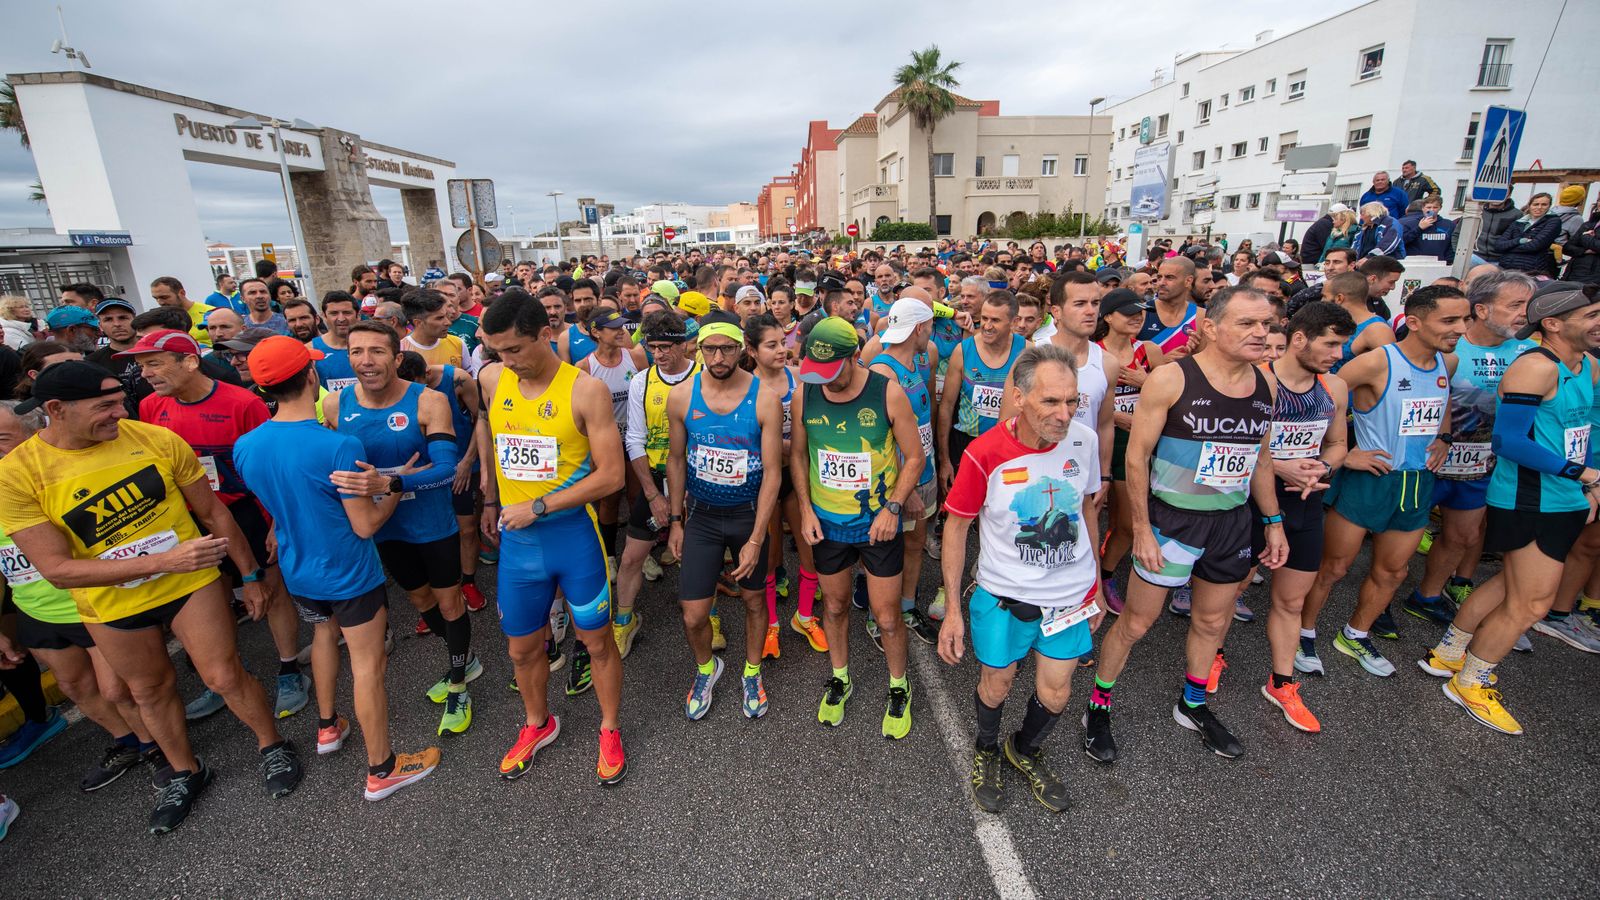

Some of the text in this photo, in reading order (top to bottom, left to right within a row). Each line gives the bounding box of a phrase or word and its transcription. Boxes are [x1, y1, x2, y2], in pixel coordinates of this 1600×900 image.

[173, 113, 238, 144] PUERTO
[244, 131, 264, 149] DE
[93, 235, 132, 245] Peatones
[1422, 233, 1446, 241] PUMA
[1472, 358, 1508, 366] TRAIL
[982, 388, 995, 396] XIV
[1411, 400, 1427, 408] XIV
[1416, 407, 1441, 422] 144
[1284, 431, 1313, 446] 482
[1573, 429, 1586, 437] XIV
[506, 438, 523, 446] XIV
[510, 447, 540, 466] 356
[706, 449, 720, 457] XIV
[826, 453, 841, 462] XIV
[1214, 446, 1234, 455] XIV
[1455, 451, 1480, 464] 104
[708, 457, 734, 474] 155
[830, 462, 857, 478] 316
[1217, 455, 1246, 472] 168
[84, 482, 144, 525] XIII
[96, 516, 118, 533] Carrera
[118, 509, 128, 519] del
[133, 511, 157, 529] TARIFA
[105, 536, 114, 546] 4
[111, 545, 138, 560] XIV
[1018, 544, 1043, 562] Vive
[1045, 545, 1056, 564] la
[6, 554, 31, 571] 20
[400, 762, 423, 773] HOKA
